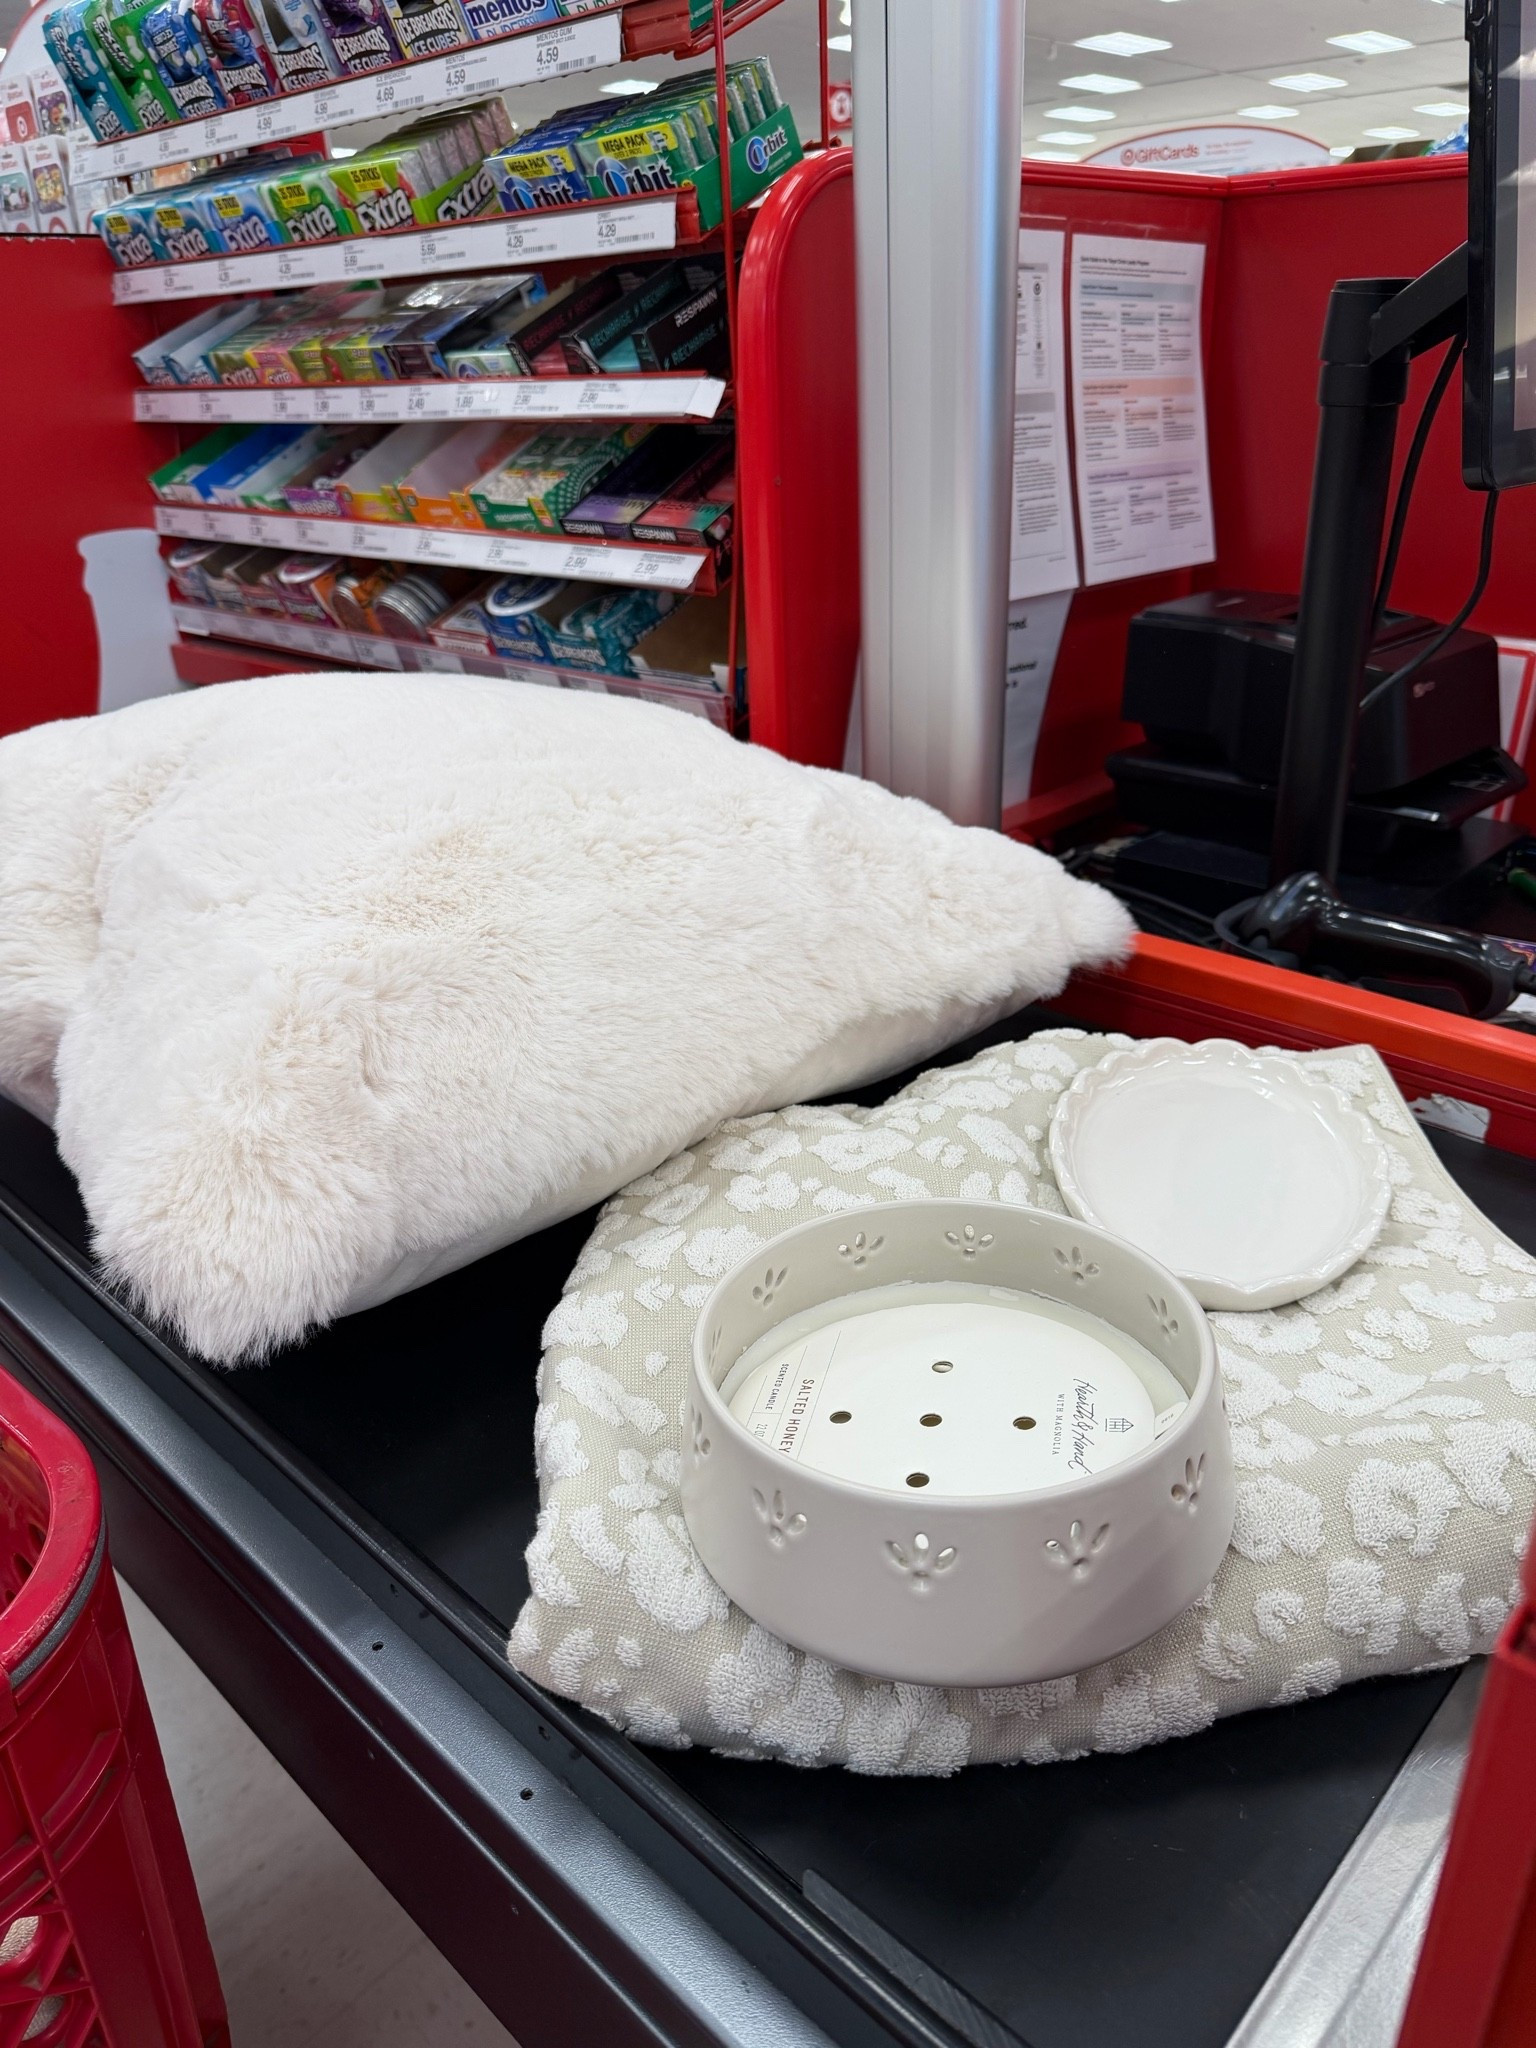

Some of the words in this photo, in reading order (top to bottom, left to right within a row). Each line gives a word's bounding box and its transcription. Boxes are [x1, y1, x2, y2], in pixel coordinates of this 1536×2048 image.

[395, 17, 411, 47] ICE
[410, 3, 458, 40] BREAKERS
[468, 0, 546, 27] mentos
[332, 37, 349, 64] ICE
[347, 25, 391, 60] BREAKERS
[412, 41, 428, 57] ICE
[425, 32, 461, 54] CUBES
[536, 29, 560, 44] MENTOS
[558, 26, 573, 38] GUM
[288, 45, 327, 72] BREAKERS
[348, 60, 362, 75] ICE
[361, 52, 393, 72] CUBES
[446, 54, 466, 64] MENTOS
[536, 46, 559, 66] 4.59
[300, 70, 329, 88] CUBES
[446, 68, 466, 87] 4.59
[376, 86, 395, 103] 4.69
[603, 138, 627, 154] MEGA
[626, 133, 648, 149] PACK
[359, 167, 381, 182] STICKS
[509, 161, 530, 173] MEGA
[529, 156, 548, 170] PACK
[595, 157, 677, 197] Orbit
[437, 165, 495, 222] Extra
[504, 176, 576, 211] Orbit
[286, 203, 337, 242] Extra
[356, 188, 413, 233] Extra
[166, 227, 209, 260] Extra
[222, 214, 269, 252] Extra
[598, 223, 617, 239] 4.29
[674, 286, 718, 328] RESPAWN
[670, 322, 719, 366] RECHARGE
[634, 561, 659, 575] 2.99
[774, 1363, 790, 1388] SCENTED
[765, 1387, 780, 1411] CANDLE
[791, 1378, 815, 1416] SALTED
[1055, 1393, 1065, 1413] WITH
[1072, 1378, 1099, 1421] Hearth
[778, 1418, 801, 1454] HONEY
[1051, 1414, 1063, 1456] MAGNOLIA
[1067, 1429, 1095, 1475] Hand
